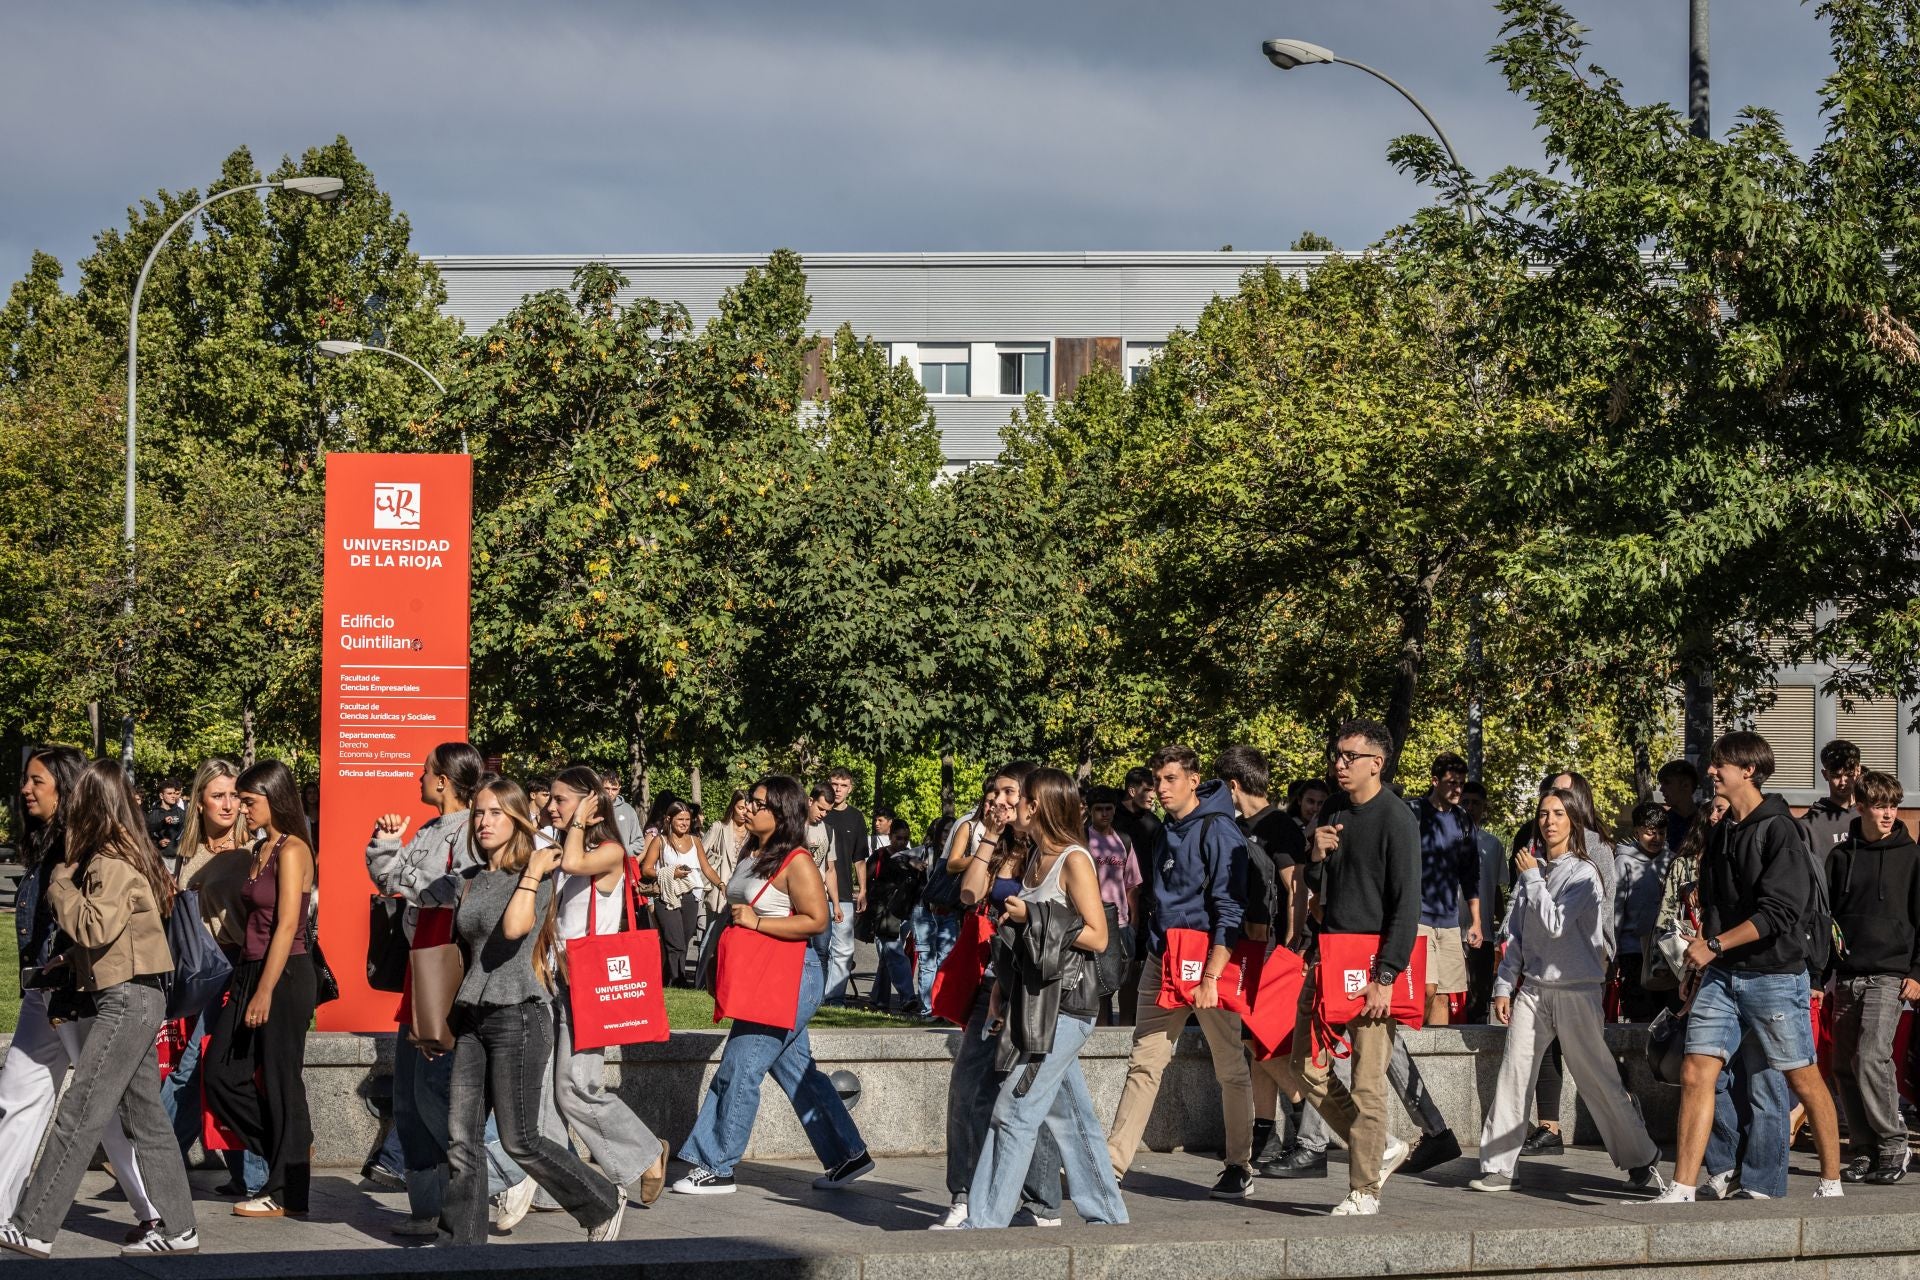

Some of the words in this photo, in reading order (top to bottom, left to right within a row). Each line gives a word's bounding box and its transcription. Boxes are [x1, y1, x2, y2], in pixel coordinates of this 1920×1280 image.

[343, 539, 450, 551] UNIVERSIDAD
[350, 555, 371, 567] DE
[375, 555, 395, 567] LA
[399, 555, 443, 570] RIOJA
[340, 614, 395, 629] Edificio
[340, 674, 370, 682] Facultad
[370, 684, 420, 692] Empresariales
[340, 712, 369, 720] Ciencias
[401, 713, 406, 722] y
[407, 713, 436, 721] Sociales
[339, 741, 369, 749] Derecho
[380, 751, 411, 759] Empresa
[339, 769, 364, 777] Oficina
[364, 769, 376, 777] del
[376, 770, 414, 778] Estudiante
[595, 982, 647, 993] UNIVERSIDAD
[623, 990, 645, 998] RIOJA
[604, 1019, 648, 1029] www.unirioja.es
